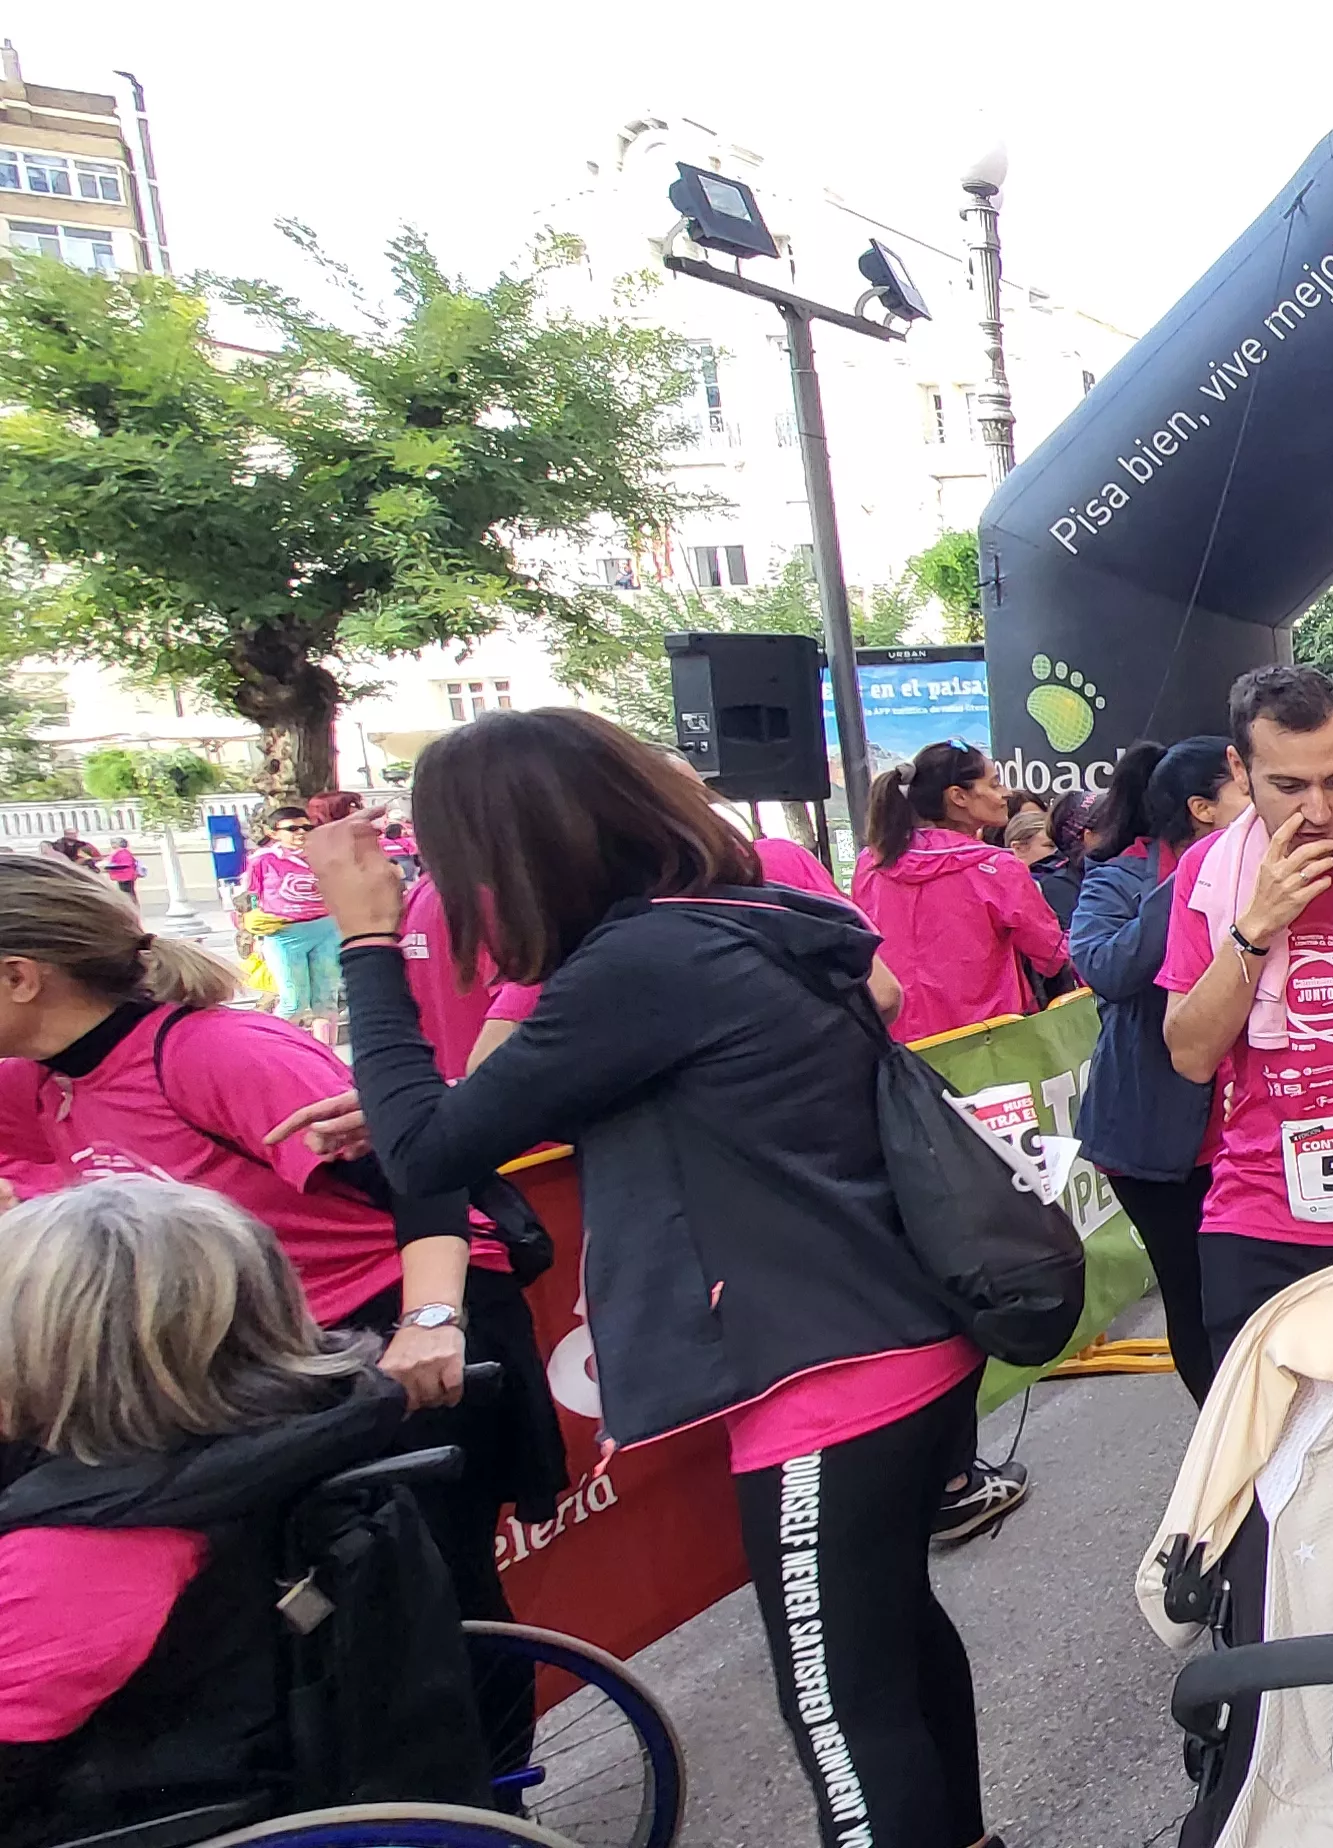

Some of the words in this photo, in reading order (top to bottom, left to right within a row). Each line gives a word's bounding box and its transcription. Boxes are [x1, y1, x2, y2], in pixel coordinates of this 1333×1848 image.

[1048, 481, 1131, 556] Pisa
[1126, 404, 1211, 486] bien,
[1198, 338, 1268, 404] vive
[870, 683, 896, 698] en
[901, 679, 922, 697] el
[927, 676, 989, 701] paisaj
[888, 650, 927, 659] URBAN
[1003, 1097, 1034, 1114] HUES
[780, 1450, 822, 1548] OURSELF
[781, 1548, 821, 1621] NEVER
[788, 1618, 834, 1724] SATISFIED
[808, 1720, 868, 1823] REINVENT
